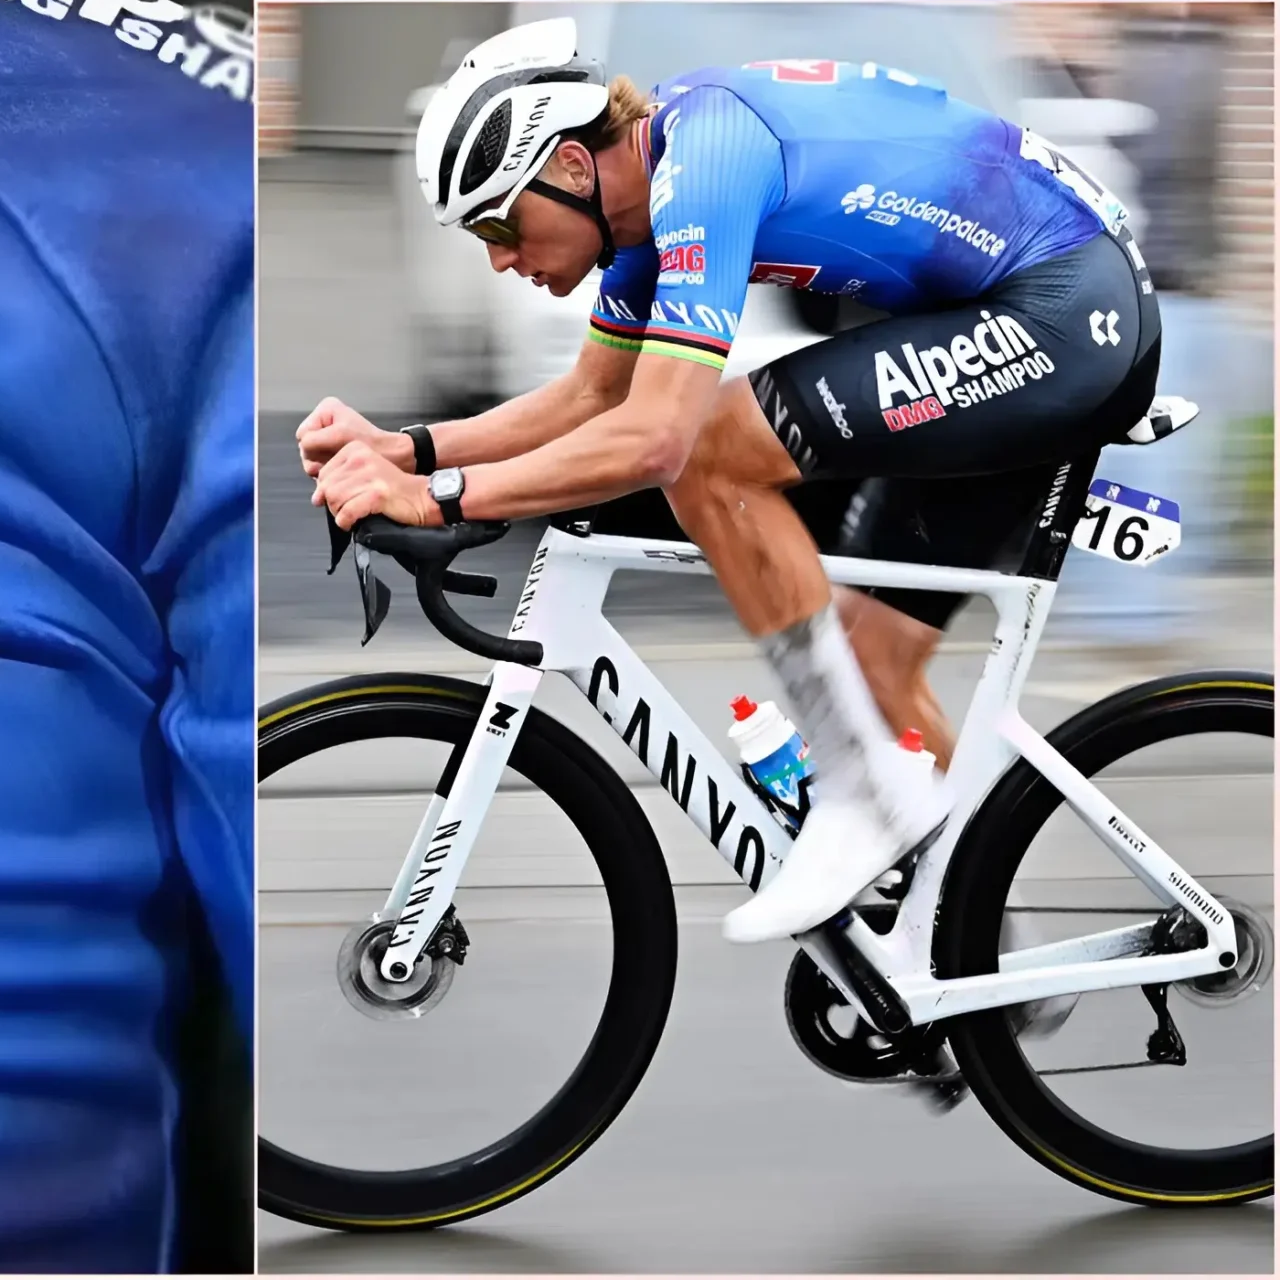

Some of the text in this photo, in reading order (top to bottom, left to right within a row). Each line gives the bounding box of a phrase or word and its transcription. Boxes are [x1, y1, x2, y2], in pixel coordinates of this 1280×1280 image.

[115, 18, 255, 102] SHA
[503, 96, 552, 172] CANYON
[877, 191, 1007, 257] Goldenpalace
[874, 310, 1038, 410] Alpecin
[951, 350, 1056, 409] SHAMPOO
[881, 395, 947, 433] DMG
[1086, 505, 1150, 562] 16
[587, 655, 766, 894] CANYO
[388, 819, 463, 948] CANYON
